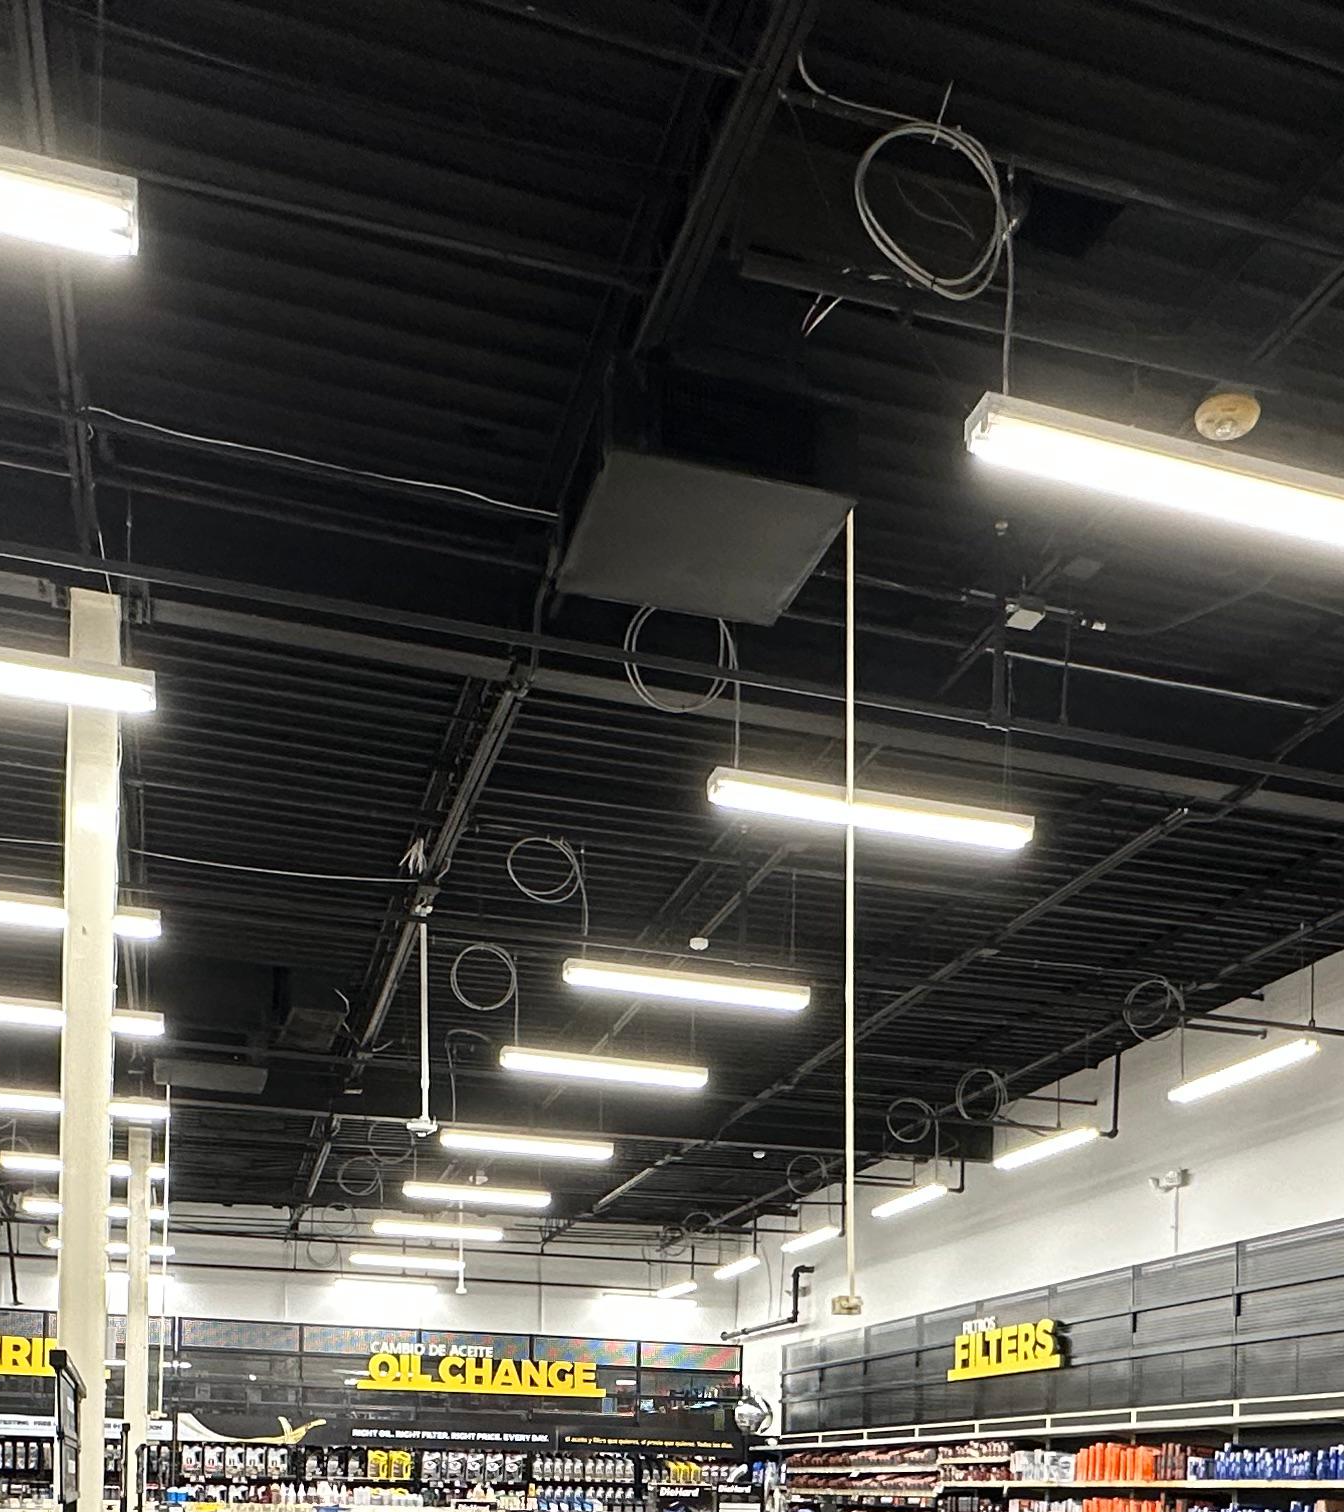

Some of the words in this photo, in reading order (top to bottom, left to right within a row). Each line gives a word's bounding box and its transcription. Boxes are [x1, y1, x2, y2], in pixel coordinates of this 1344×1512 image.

[370, 1341, 424, 1356] CAMBIO
[430, 1345, 446, 1356] DE
[451, 1345, 493, 1358] ACEITE
[955, 1319, 1055, 1371] FILTERS
[368, 1353, 432, 1383] OIL
[438, 1356, 597, 1388] CHANGE
